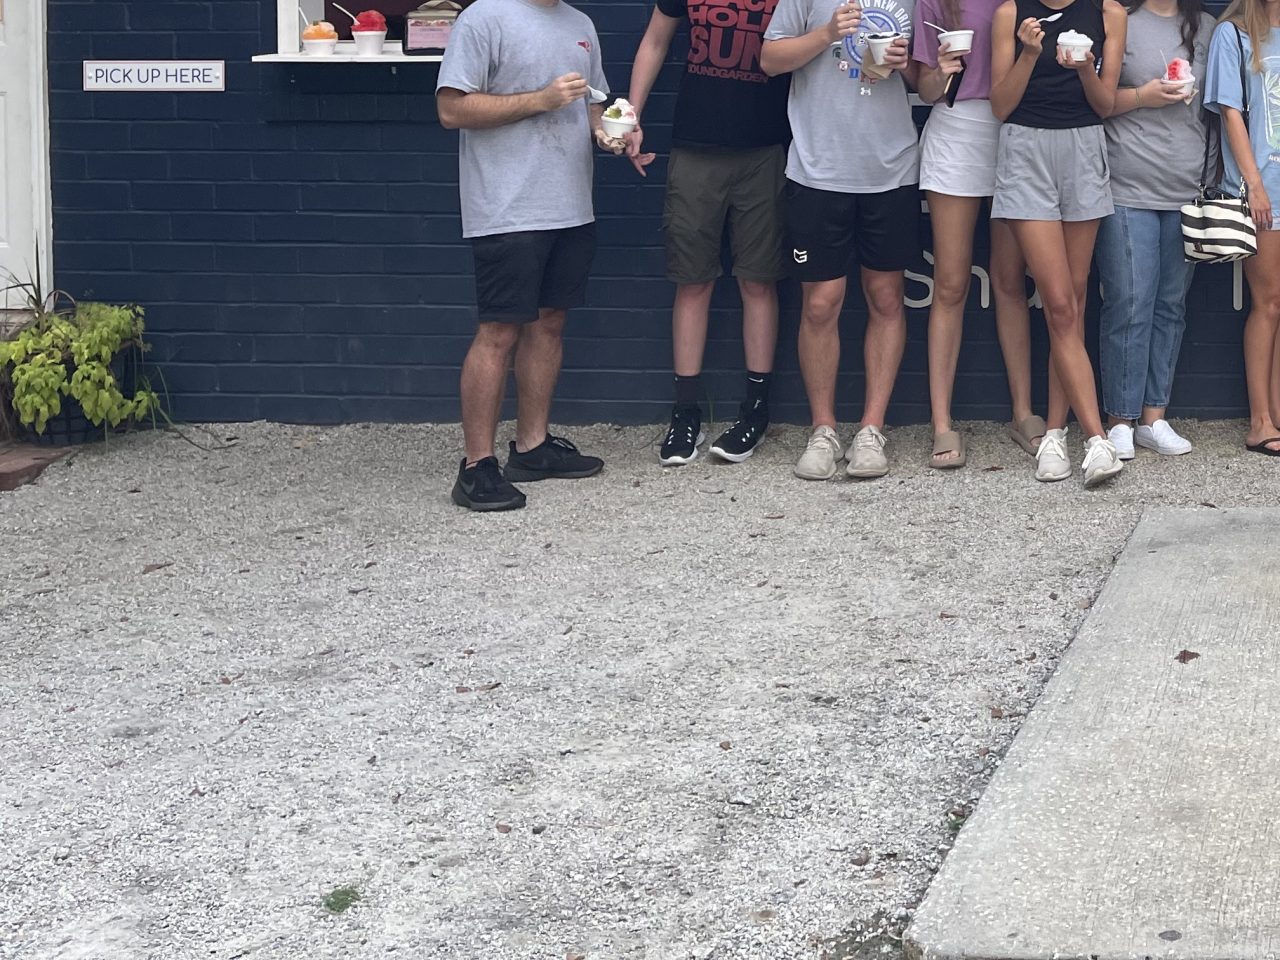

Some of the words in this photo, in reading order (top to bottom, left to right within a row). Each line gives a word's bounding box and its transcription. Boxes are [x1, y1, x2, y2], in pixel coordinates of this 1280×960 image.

[687, 25, 762, 71] SUN
[95, 68, 133, 84] PICK
[137, 68, 161, 84] UP
[165, 68, 213, 83] HERE
